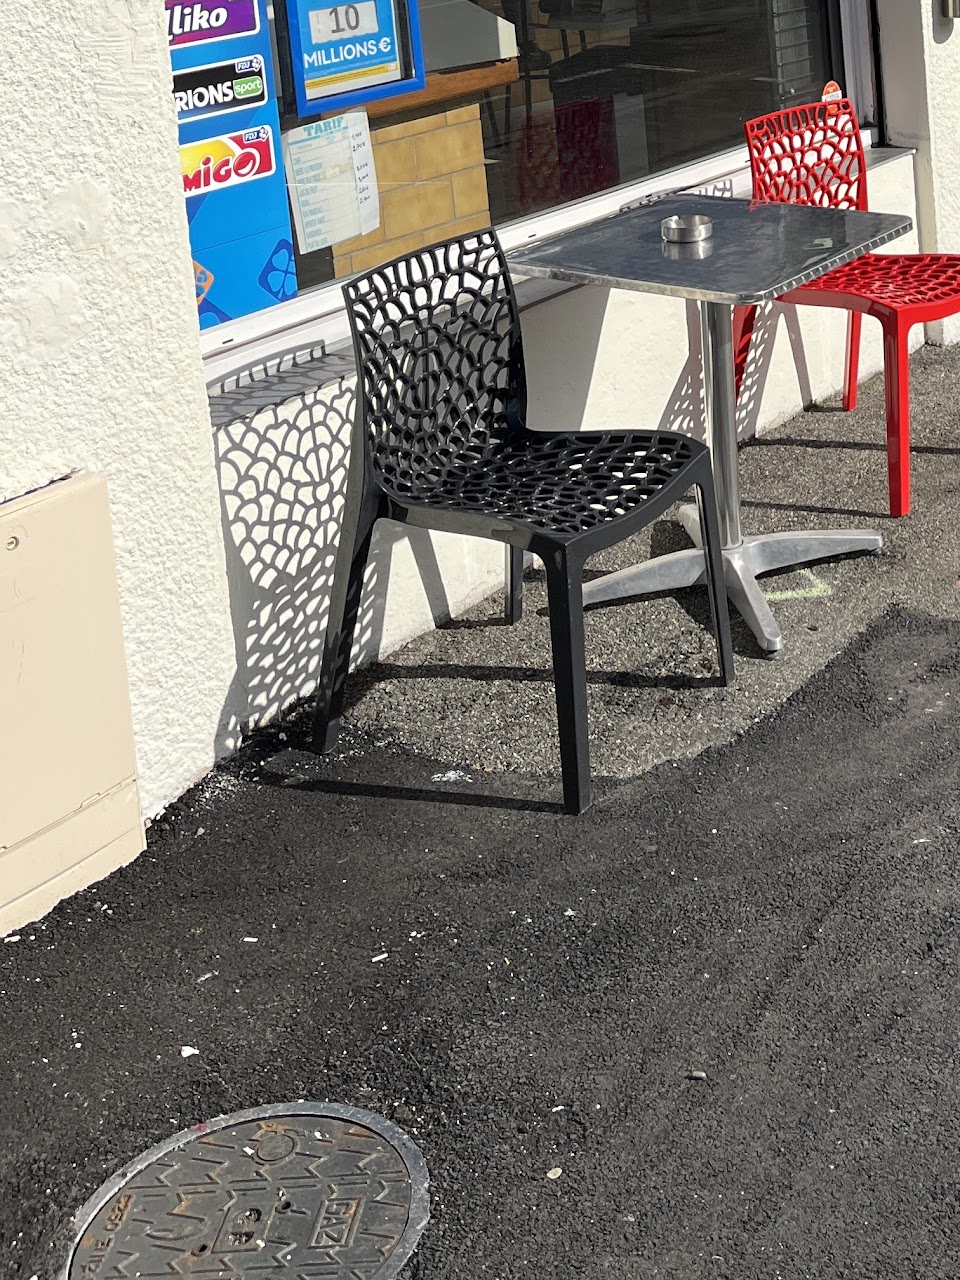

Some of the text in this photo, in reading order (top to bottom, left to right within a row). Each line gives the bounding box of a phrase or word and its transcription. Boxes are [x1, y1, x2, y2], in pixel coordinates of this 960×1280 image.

[329, 4, 360, 34] 10
[303, 40, 377, 69] MILLIONS
[234, 79, 262, 95] sport
[303, 116, 344, 137] TARIF
